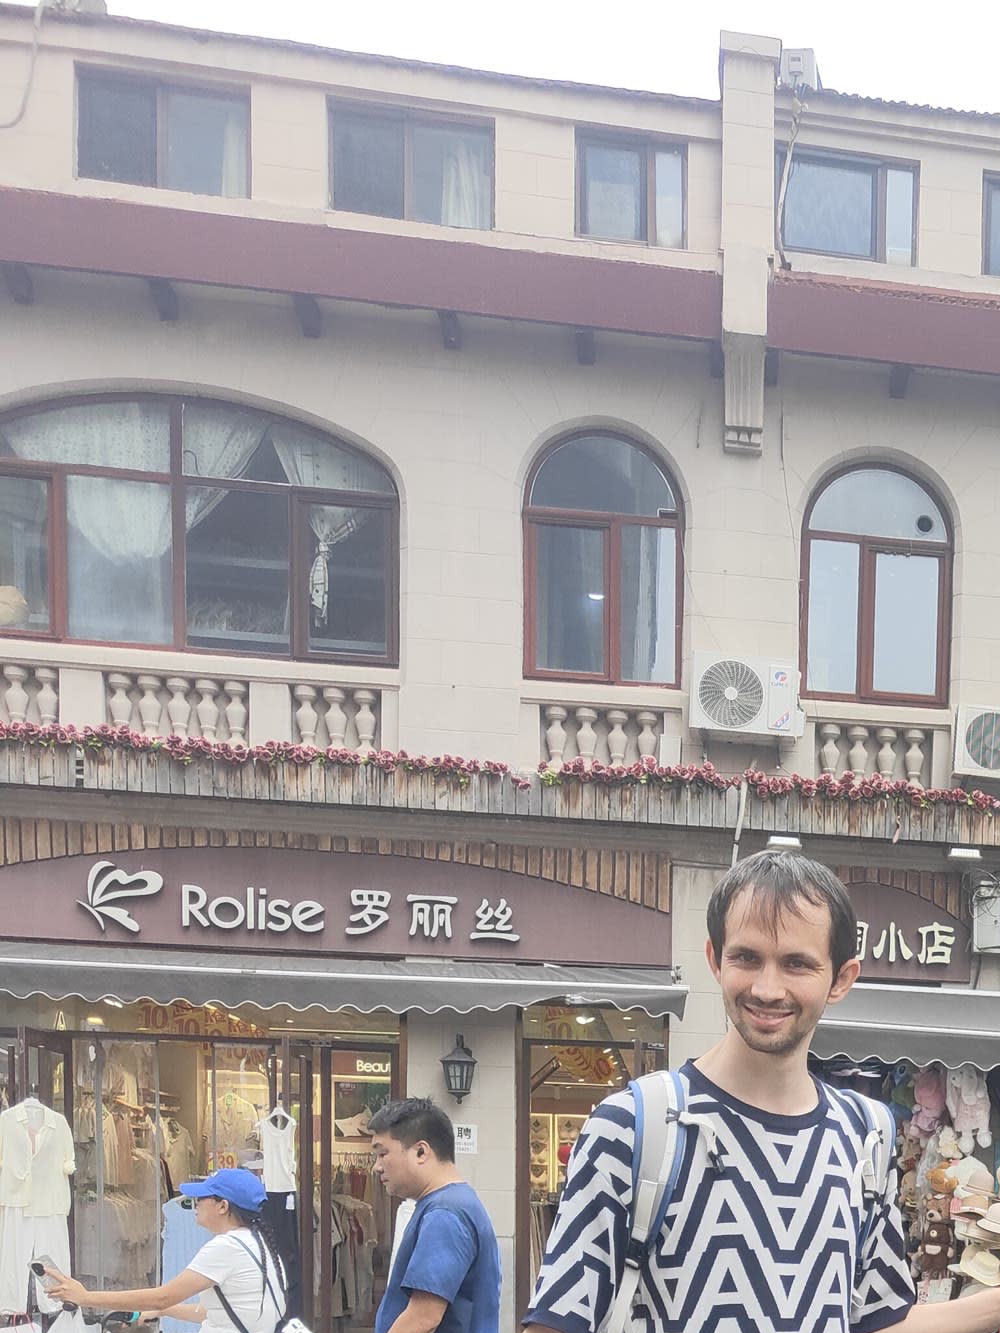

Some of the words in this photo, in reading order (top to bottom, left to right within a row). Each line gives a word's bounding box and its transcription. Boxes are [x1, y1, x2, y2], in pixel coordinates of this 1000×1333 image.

[181, 884, 326, 933] Rolise
[345, 889, 521, 942] 罗丽丝
